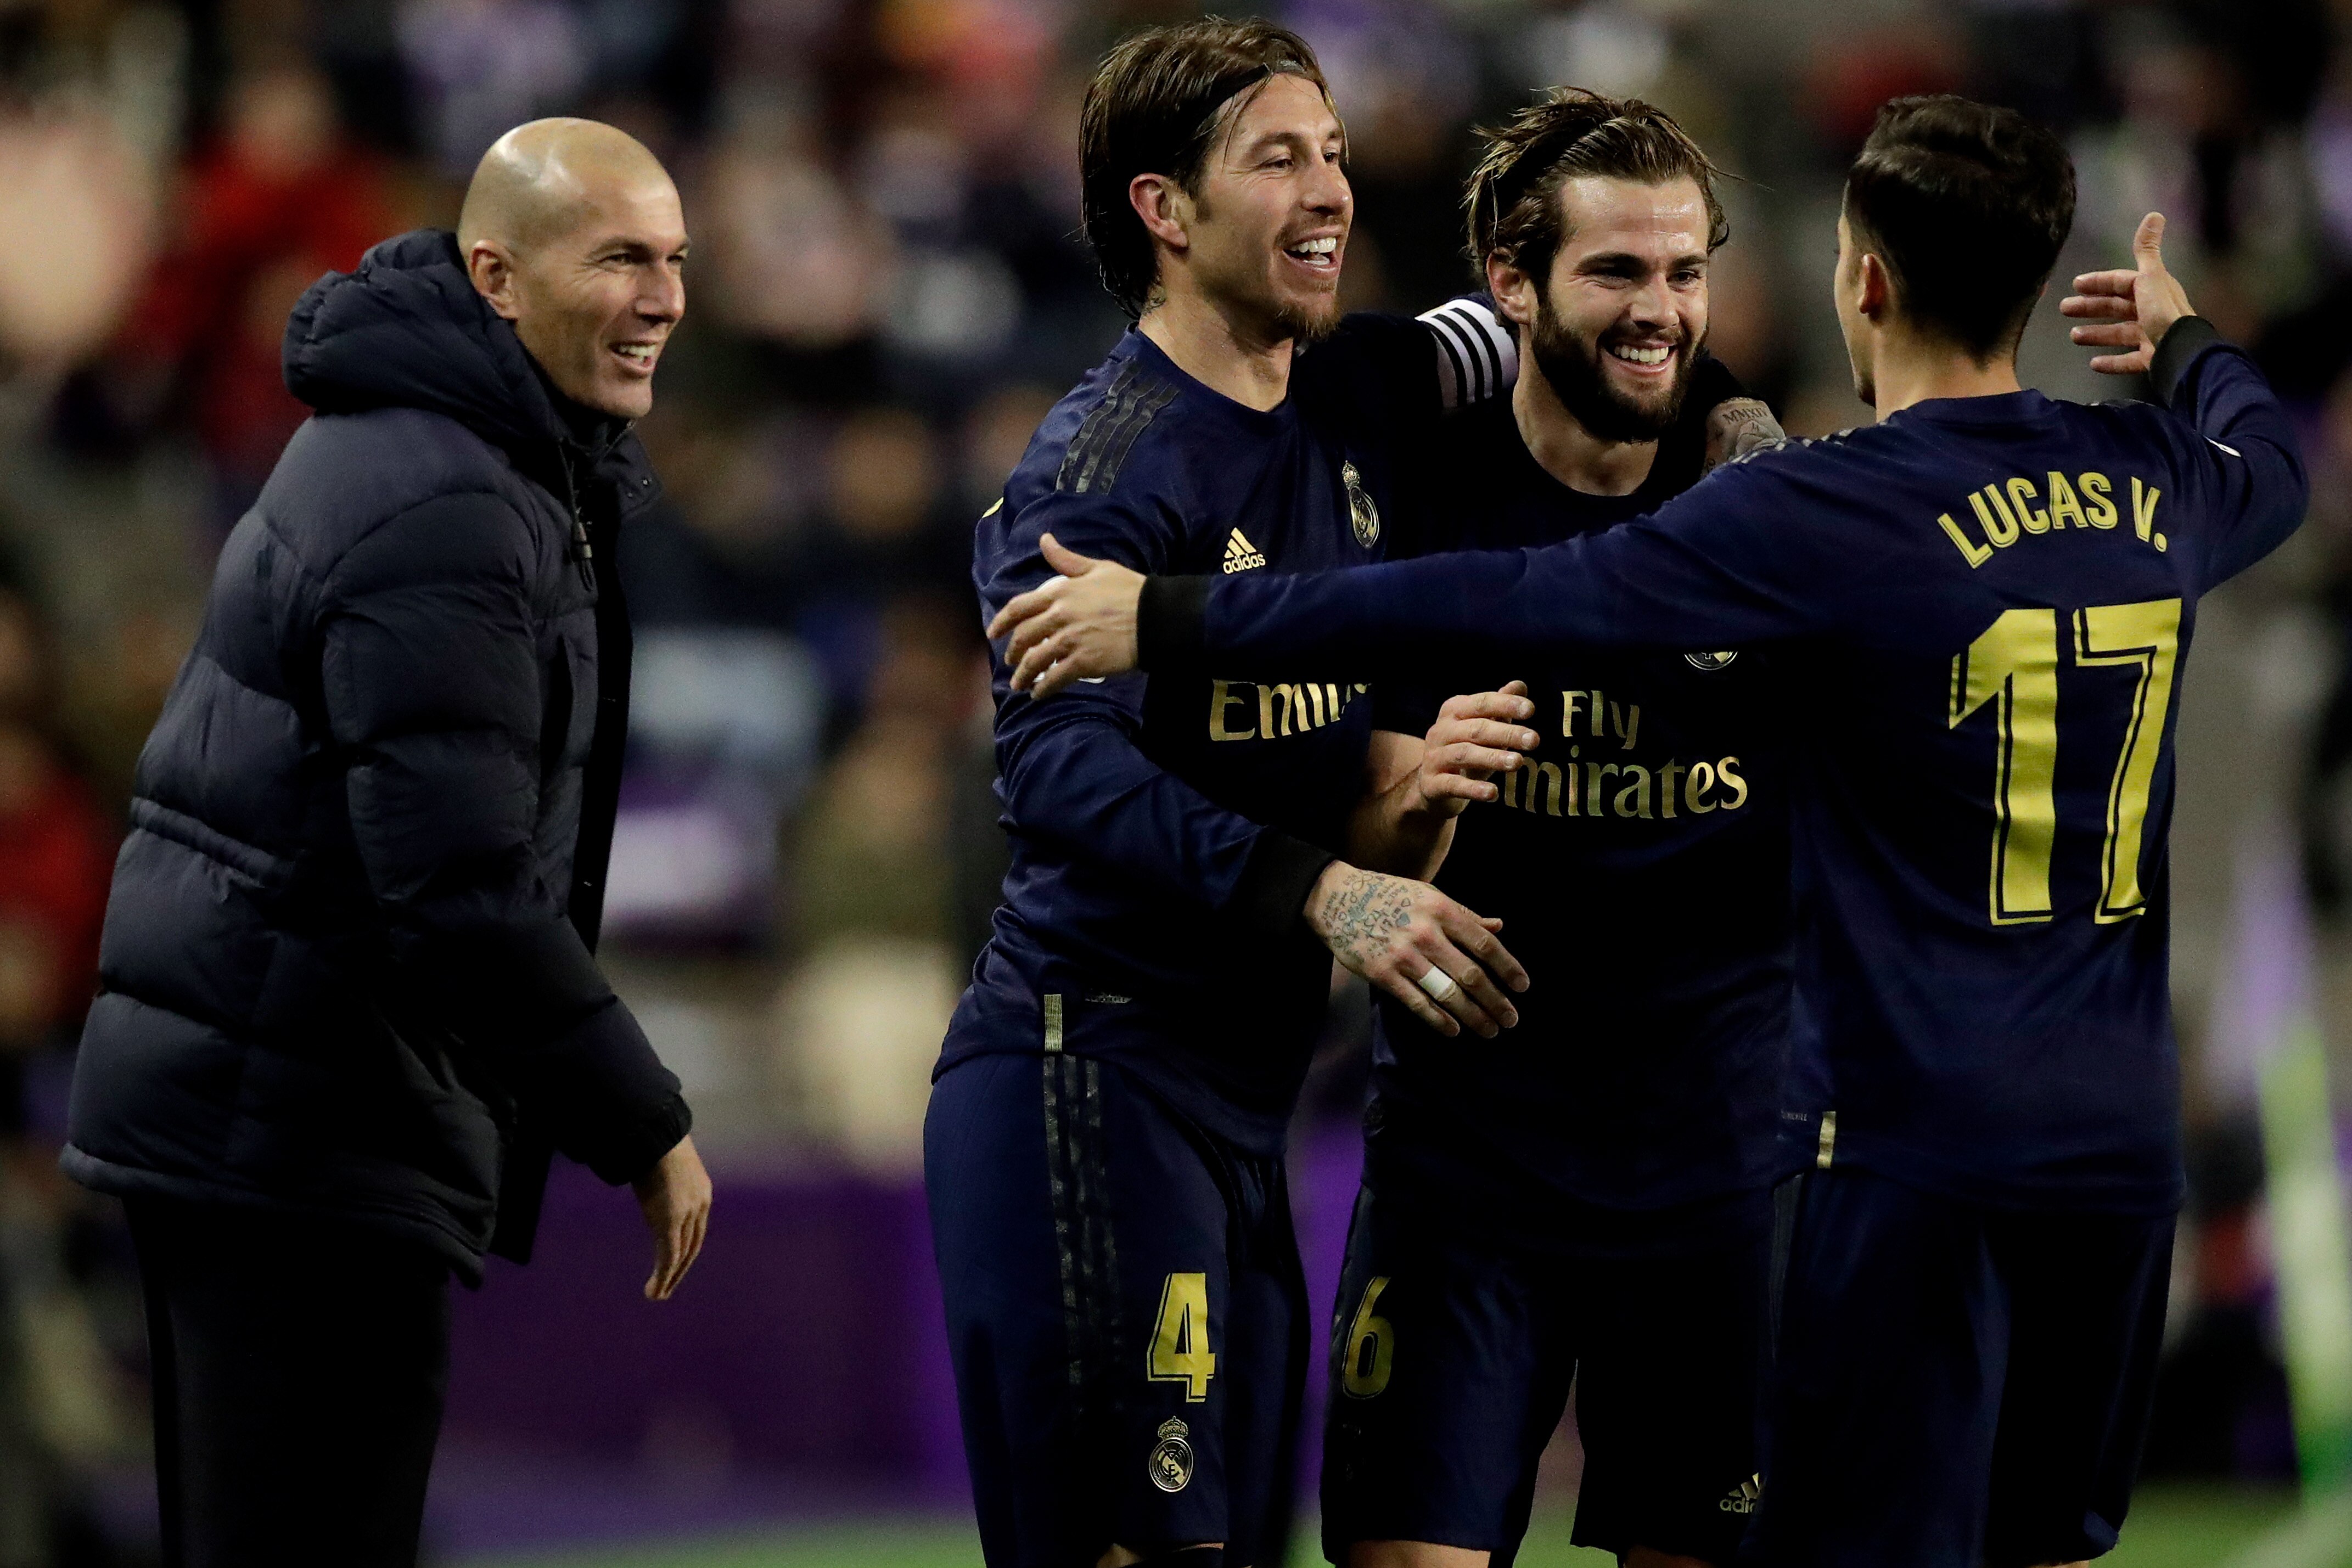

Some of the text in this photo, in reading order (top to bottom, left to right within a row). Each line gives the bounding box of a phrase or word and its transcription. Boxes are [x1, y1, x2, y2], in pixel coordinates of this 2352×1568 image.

[1222, 552, 1267, 576] adidas
[1937, 470, 2168, 570] LUCAS V.
[1562, 689, 1641, 750] Fly
[1949, 597, 2183, 926] 17
[1504, 744, 1749, 819] mirates
[1147, 1272, 1216, 1403] 4
[1341, 1275, 1395, 1400] 6
